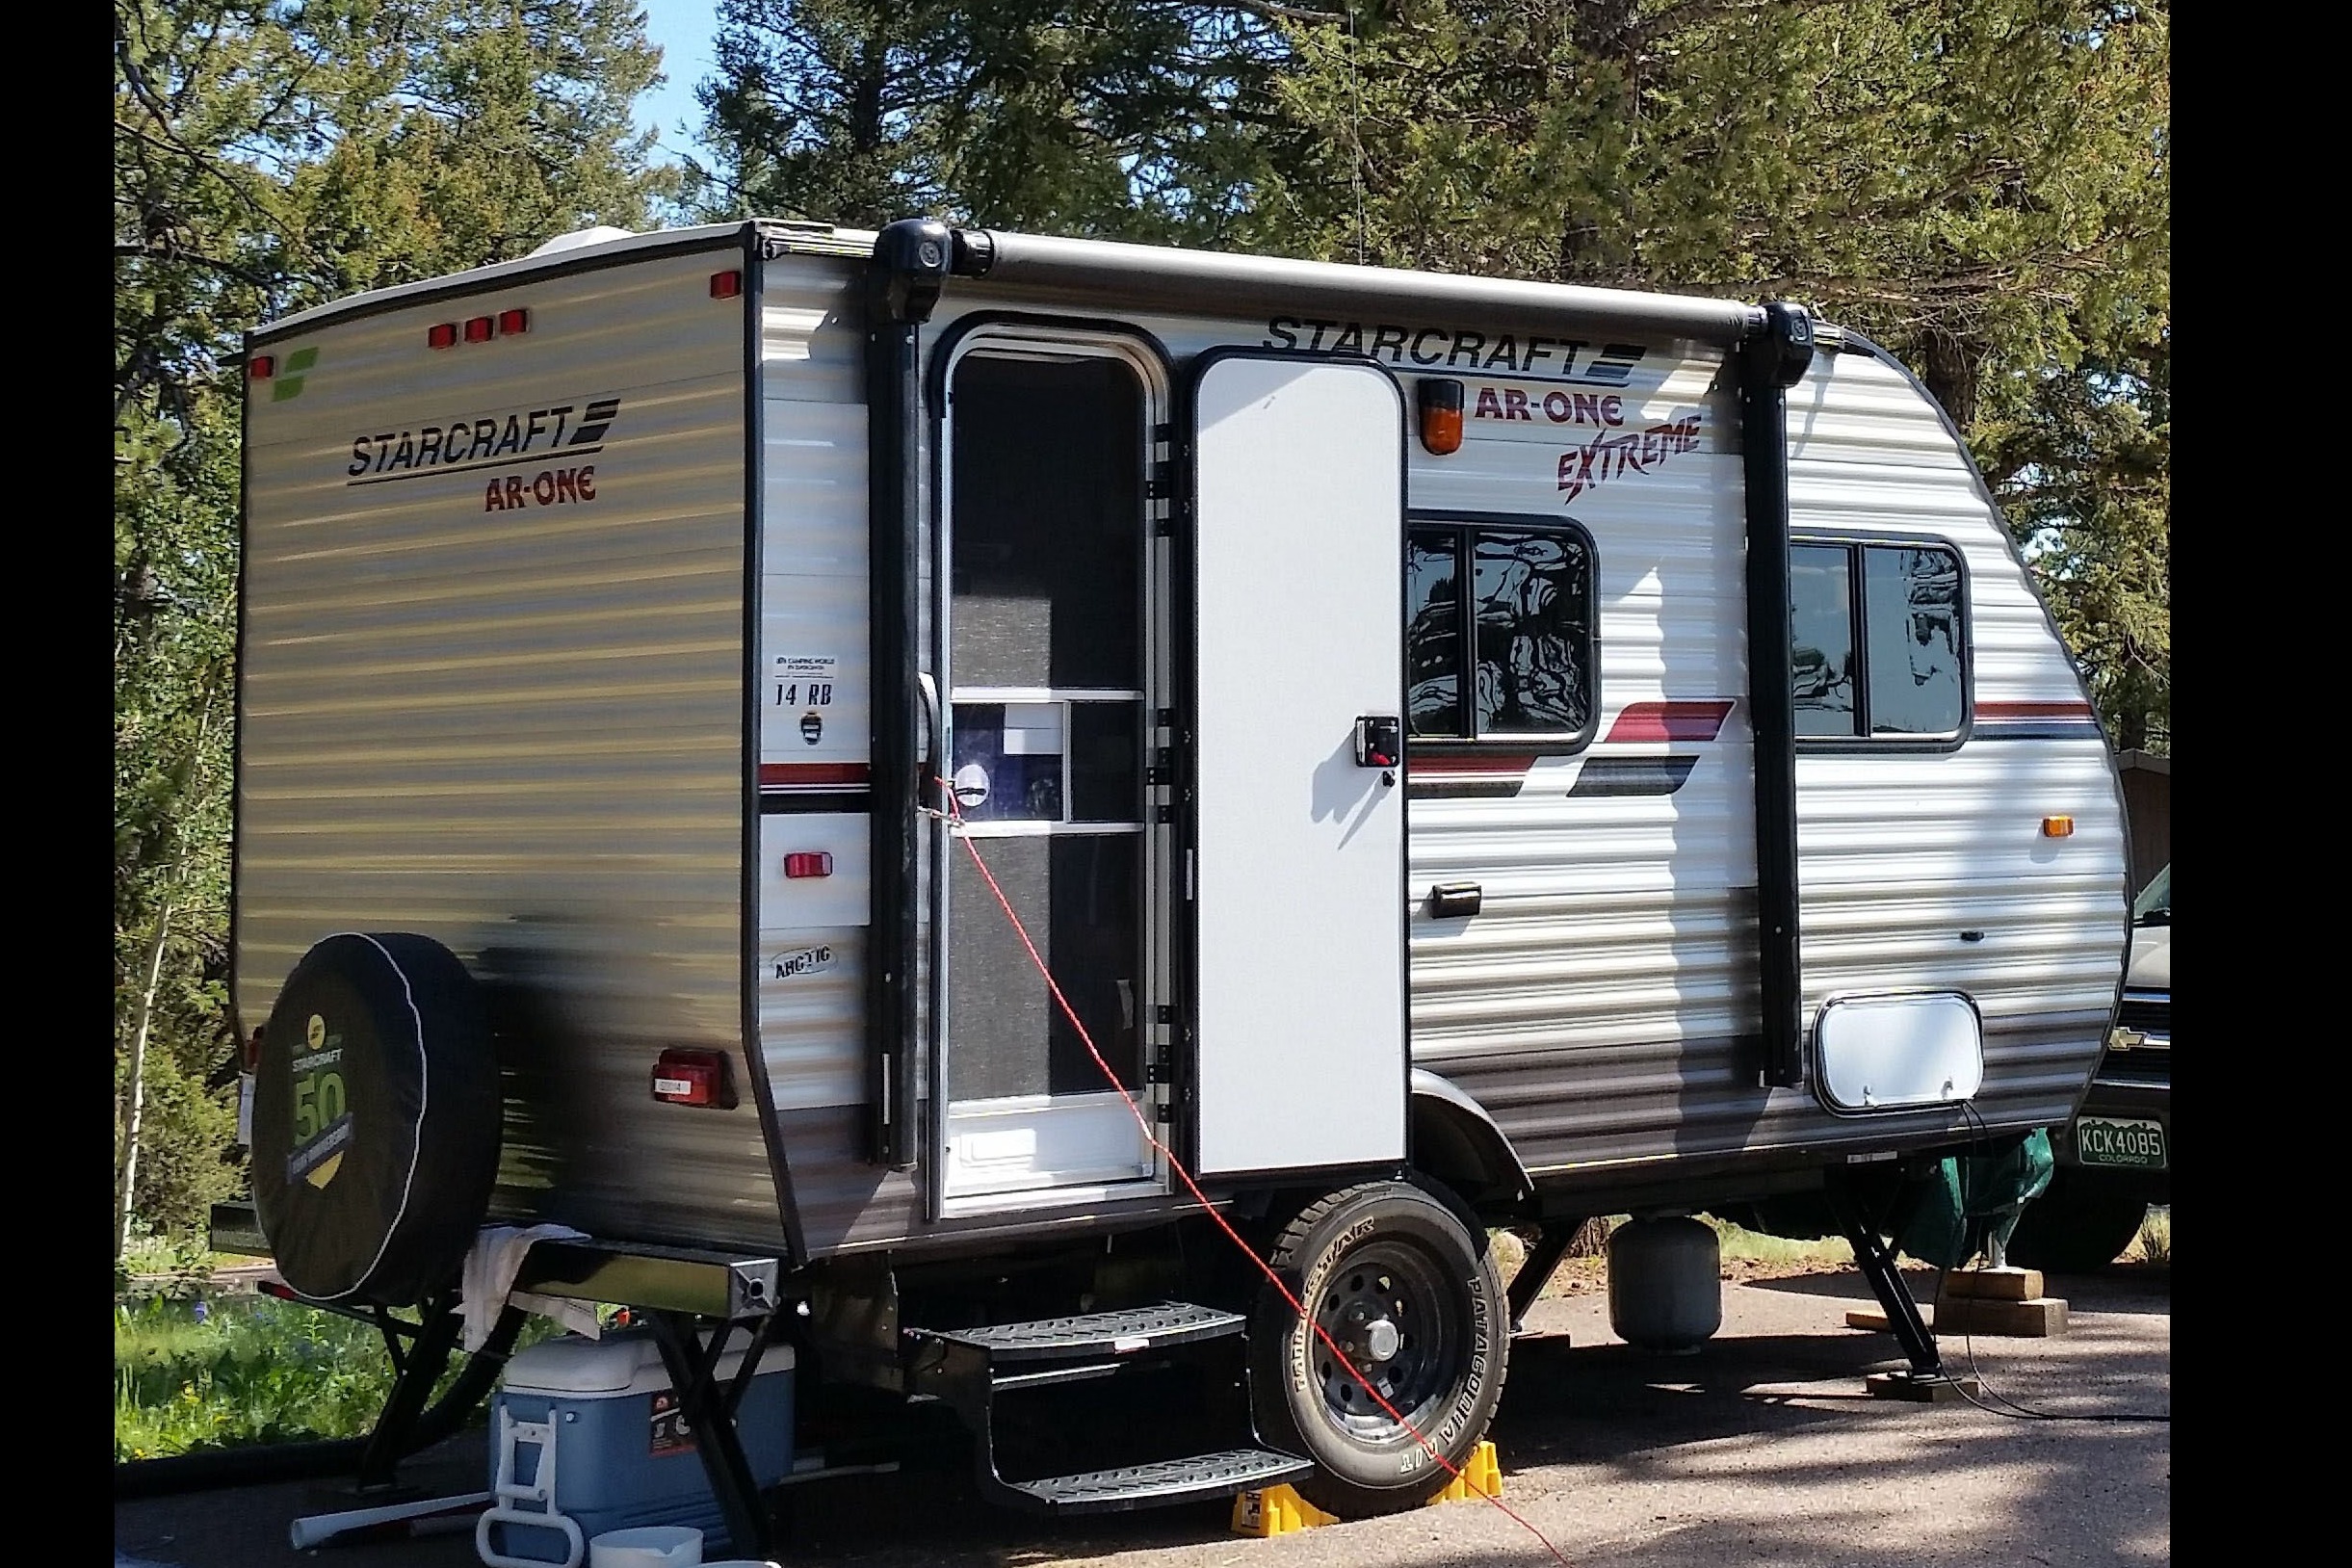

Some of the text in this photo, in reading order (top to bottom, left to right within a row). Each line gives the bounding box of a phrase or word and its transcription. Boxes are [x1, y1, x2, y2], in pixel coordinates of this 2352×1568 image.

[1263, 316, 1589, 376] STARCRAFT
[1475, 387, 1624, 428] AR-ONE
[347, 405, 573, 477] STARCRAFT
[1557, 414, 1702, 506] EXTREME
[483, 465, 596, 512] AR-ONE
[776, 684, 832, 705] 14 RB
[775, 946, 830, 979] ARCTIC
[295, 1072, 346, 1146] 50
[2081, 1129, 2160, 1155] KCK4085
[2100, 1154, 2148, 1163] COLORADO
[1439, 1276, 1490, 1445] PATAGONIA
